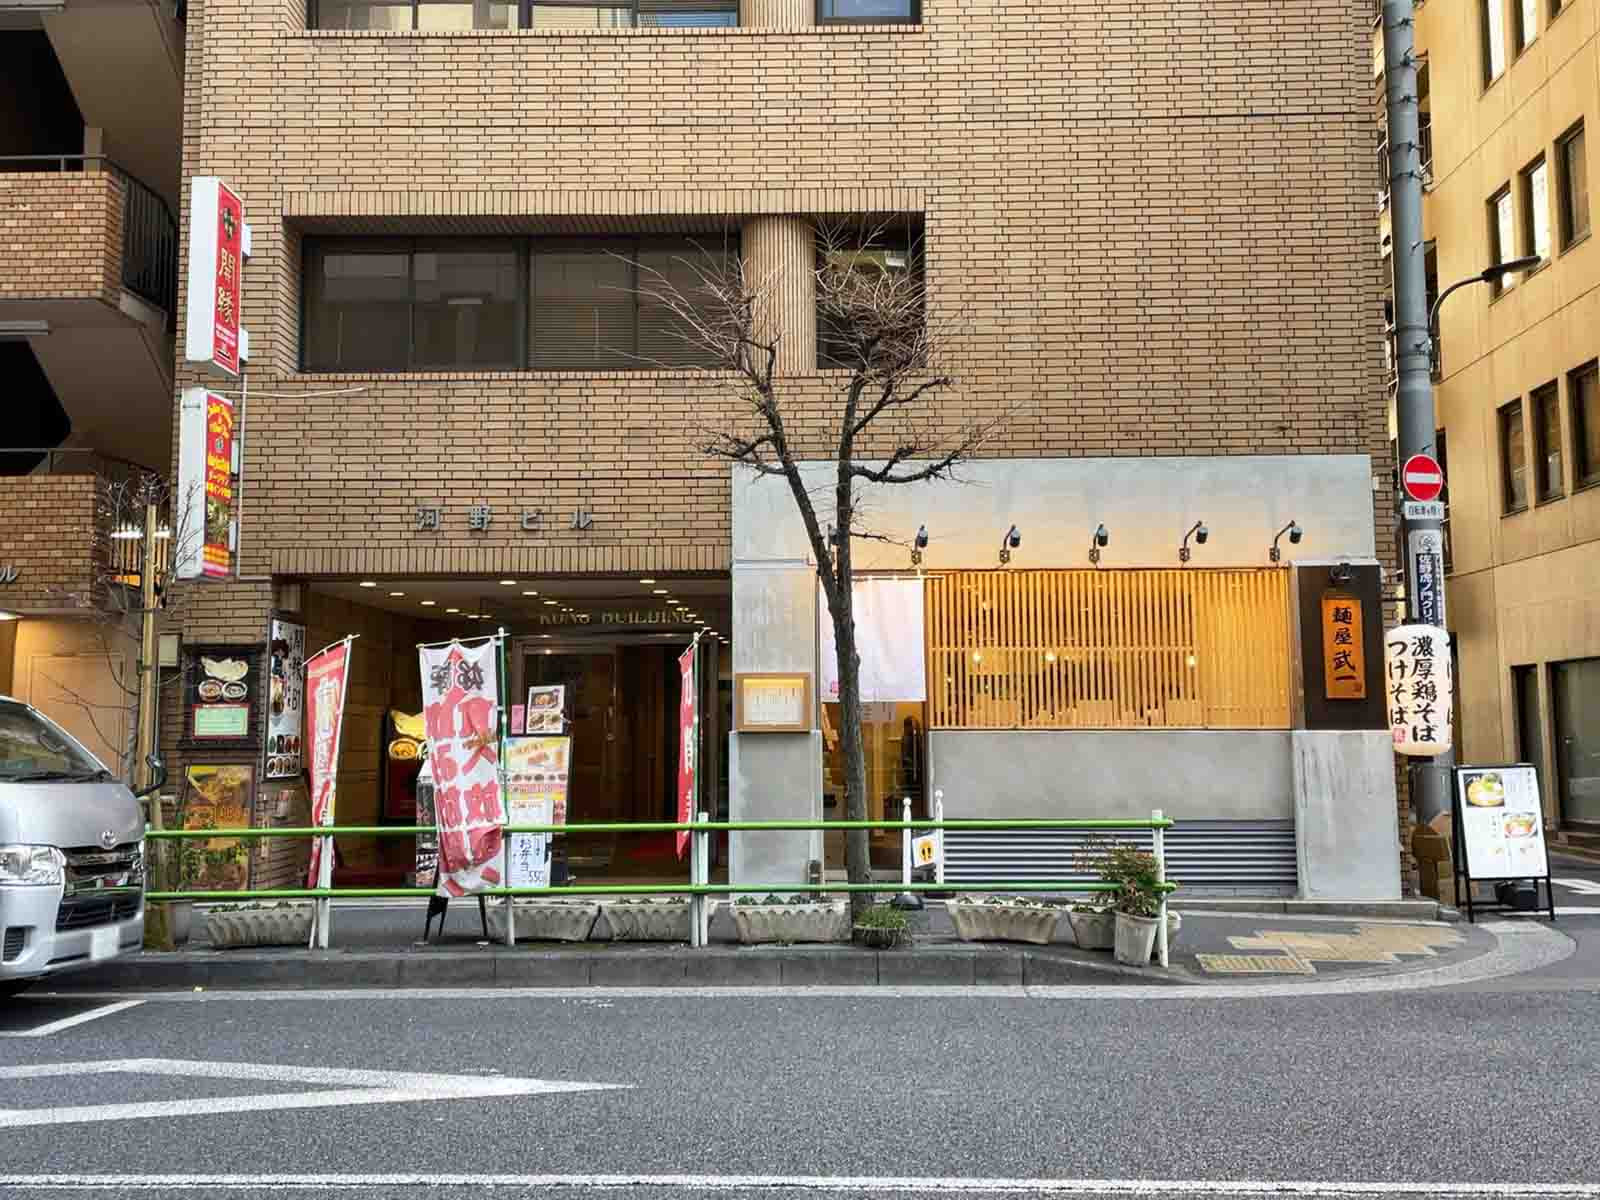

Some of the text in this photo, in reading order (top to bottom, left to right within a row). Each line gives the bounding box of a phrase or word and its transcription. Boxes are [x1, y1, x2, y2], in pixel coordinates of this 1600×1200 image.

[415, 505, 593, 532] 河野ビル
[1332, 606, 1357, 682] 麺屋武一
[1387, 640, 1409, 726] つけそば
[1410, 634, 1438, 743] 濃厚鶏そば
